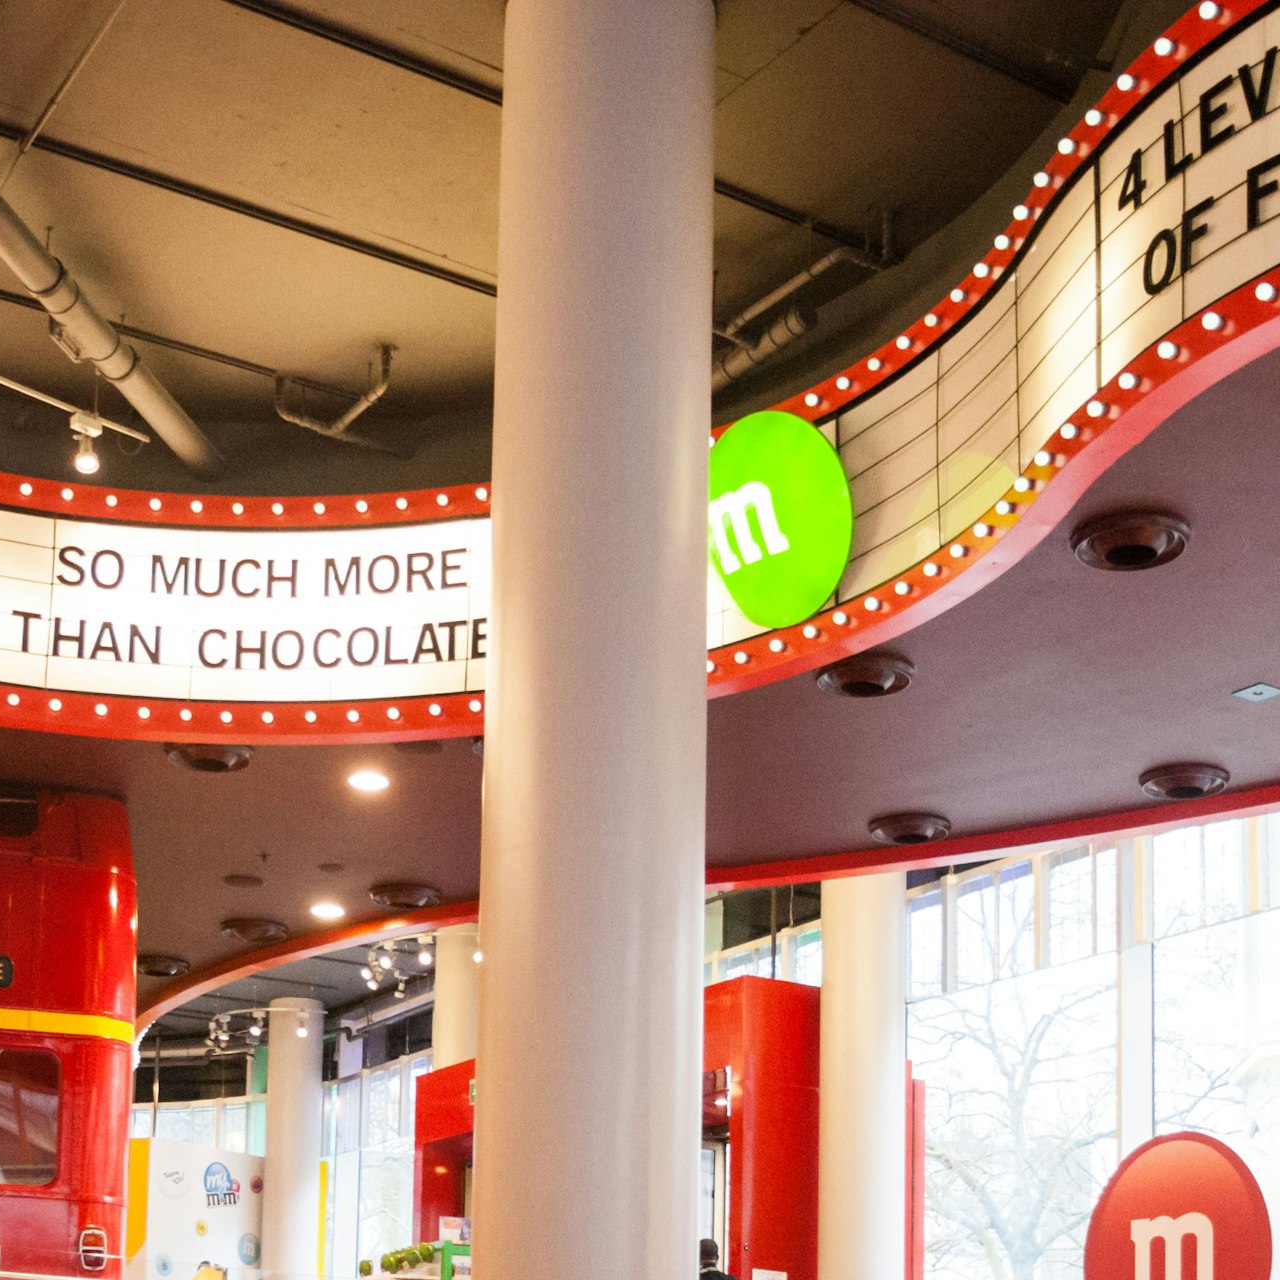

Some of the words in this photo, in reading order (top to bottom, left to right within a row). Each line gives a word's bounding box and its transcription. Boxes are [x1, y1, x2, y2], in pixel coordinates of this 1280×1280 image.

[1116, 149, 1148, 213] 4
[1142, 196, 1214, 297] OF
[56, 545, 126, 590] SO
[150, 553, 299, 599] MUCH
[323, 548, 468, 598] MORE
[12, 609, 162, 665] THAN
